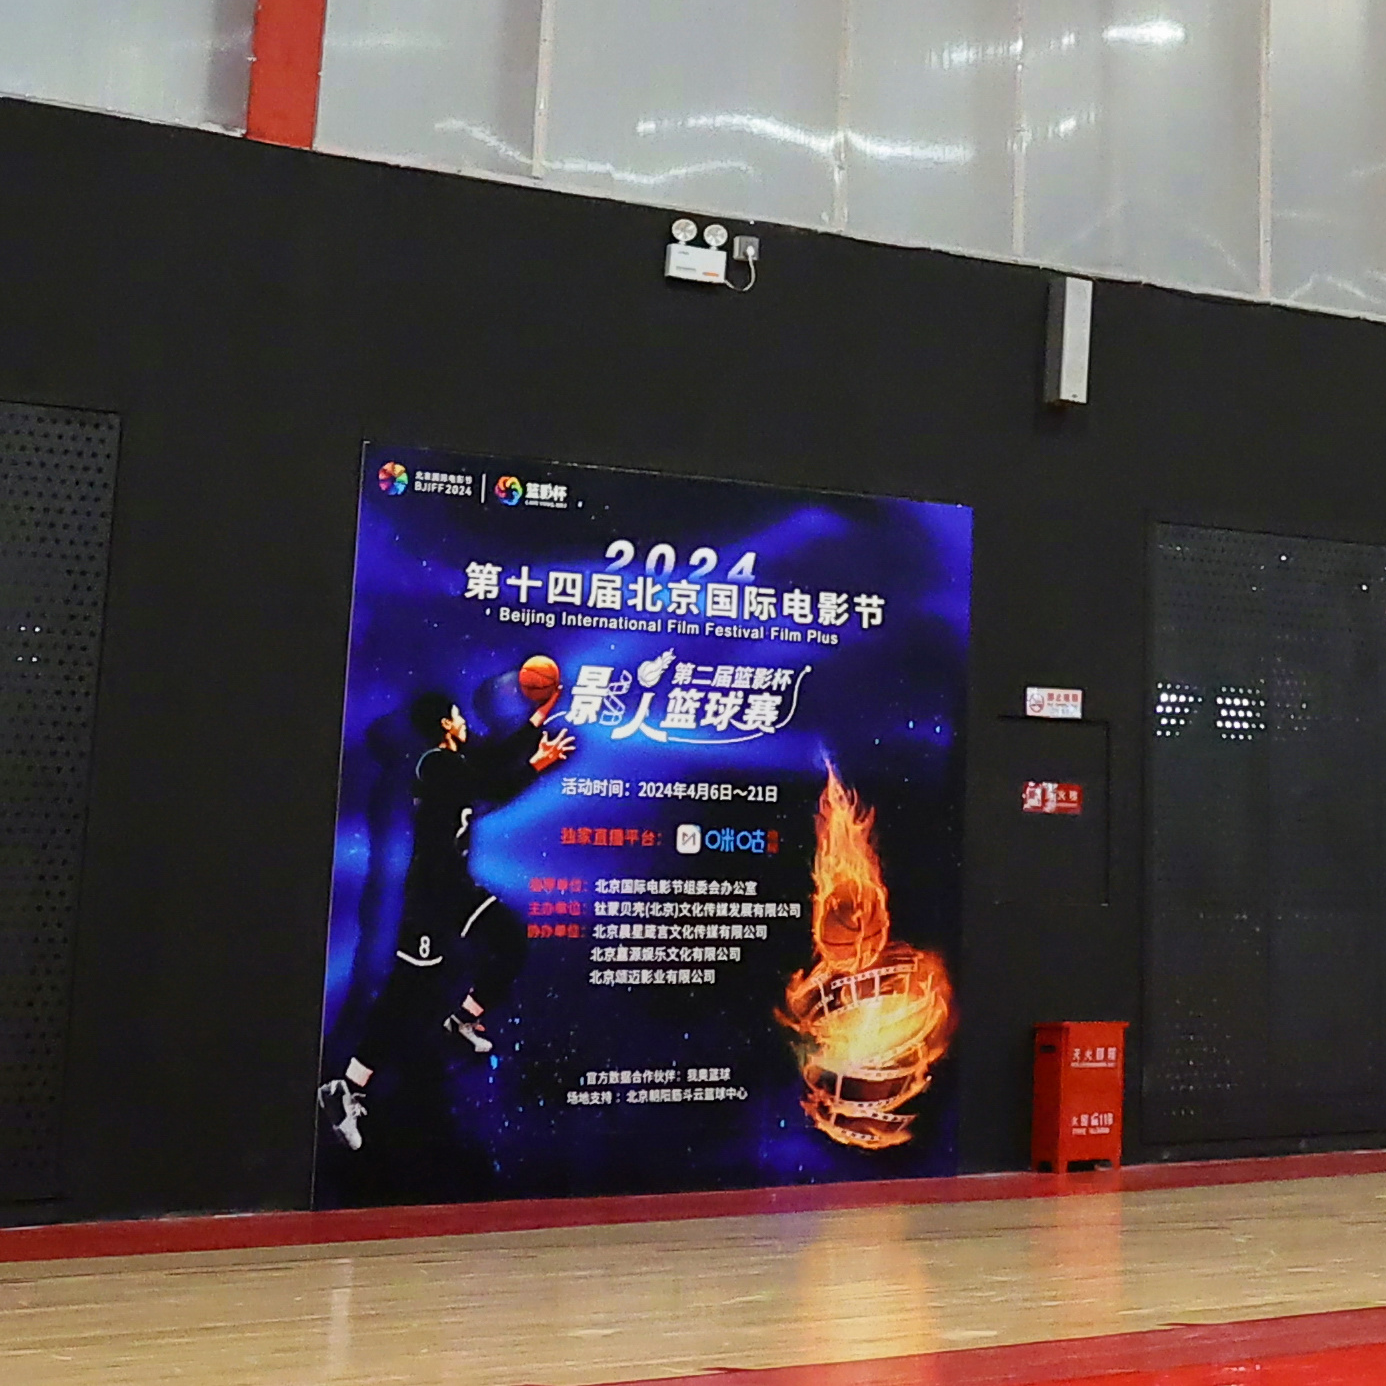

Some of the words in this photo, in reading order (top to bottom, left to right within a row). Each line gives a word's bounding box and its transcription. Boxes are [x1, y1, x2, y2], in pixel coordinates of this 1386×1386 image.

[414, 482, 444, 493] BJIFF
[445, 484, 472, 496] 2024
[605, 539, 757, 582] 2024
[464, 561, 886, 630] 第十四届北京国际电影节
[499, 607, 556, 627] Beijing
[561, 611, 662, 633] International
[667, 618, 700, 635] Film
[705, 622, 764, 640] Festival
[770, 627, 802, 643] Film
[807, 630, 839, 645] Plus
[671, 662, 795, 692] 第二届篮影杯
[419, 935, 431, 959] 8
